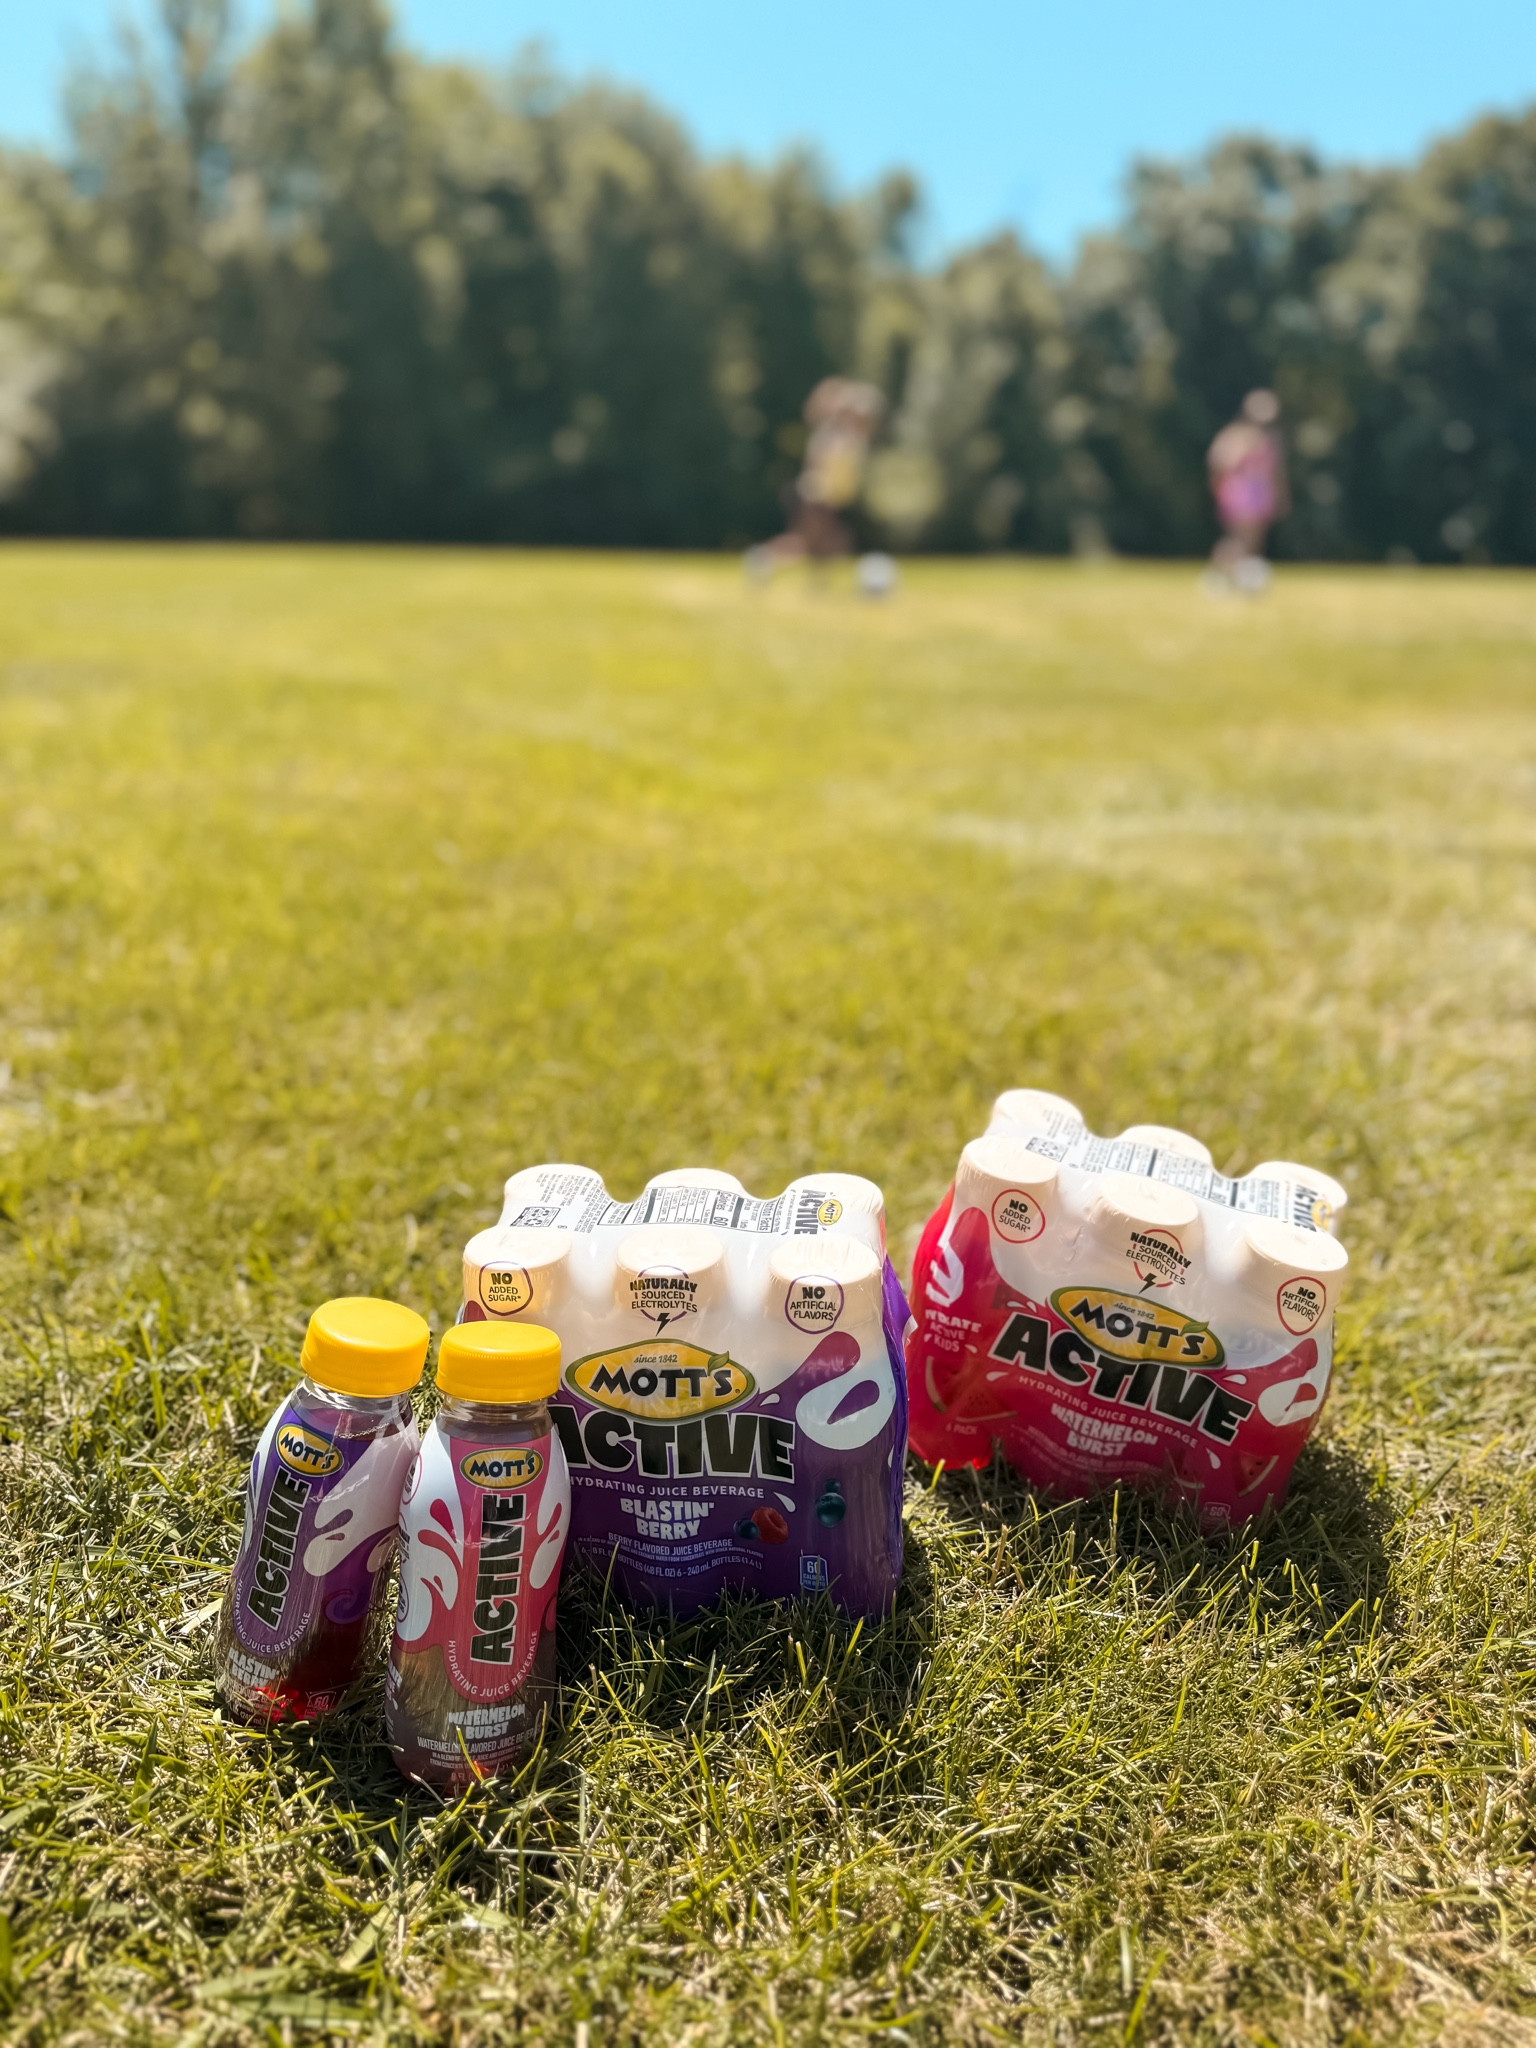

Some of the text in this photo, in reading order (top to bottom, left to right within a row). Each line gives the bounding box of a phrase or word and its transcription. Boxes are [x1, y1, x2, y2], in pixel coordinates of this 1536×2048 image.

[794, 1189, 827, 1235] ACTIVE
[1002, 1208, 1031, 1225] ADDED
[1009, 1199, 1028, 1214] NO
[713, 1216, 729, 1226] 60
[1130, 1231, 1192, 1269] NATURALLY
[1139, 1245, 1177, 1270] SOURCED
[491, 1272, 513, 1285] NO
[1126, 1249, 1186, 1286] ELECTROLYTES
[489, 1286, 518, 1295] ADDED
[629, 1278, 698, 1292] NATURALLY
[641, 1290, 685, 1300] SOURCED
[802, 1286, 826, 1299] NO
[1297, 1286, 1316, 1300] NO
[632, 1300, 698, 1313] ELECTROLYTES
[790, 1301, 836, 1311] ARTIFICIAL
[1113, 1302, 1155, 1321] since 1842
[1282, 1291, 1320, 1315] ARTIFICIAL
[1282, 1299, 1316, 1322] FLAVORS
[794, 1310, 834, 1321] FLAVORS
[1069, 1297, 1206, 1356] MOTT'S
[934, 1334, 960, 1352] KIDS
[634, 1354, 678, 1364] since 1842
[589, 1360, 734, 1398] MOTT'S
[987, 1312, 1256, 1446] ACTIVE
[1019, 1375, 1198, 1448] HYDRATING JUICE BEVERAGE
[1051, 1402, 1159, 1446] WATERMELON
[280, 1432, 335, 1469] MOTT'S
[1066, 1431, 1129, 1457] BURST
[469, 1456, 535, 1478] MOTT'S
[649, 1485, 687, 1496] JUICE
[693, 1485, 764, 1498] BEVERAGE
[620, 1498, 715, 1522] BLASTIN'
[636, 1517, 700, 1540] BERRY
[247, 1465, 312, 1631] ACTIVE
[608, 1532, 733, 1557] BERRY FLAVORED JUICE BEVERAGE
[618, 1554, 643, 1571] BOTTLES
[655, 1567, 664, 1577] FL
[664, 1568, 676, 1578] OZ)
[700, 1561, 712, 1573] mL
[711, 1555, 741, 1566] BOTTLES
[470, 1493, 526, 1665] ACTIVE
[234, 1580, 311, 1653] HYDRATING JUICE BEVERAGE
[229, 1647, 280, 1680] BLASTIN'
[448, 1640, 478, 1695] HYDRATING
[480, 1684, 510, 1697] JUICE
[512, 1630, 537, 1687] BEVERAGE
[448, 1704, 525, 1726] WATERMELON
[466, 1722, 509, 1740] BURST
[497, 1737, 515, 1750] JUICE
[458, 1772, 466, 1782] FL
